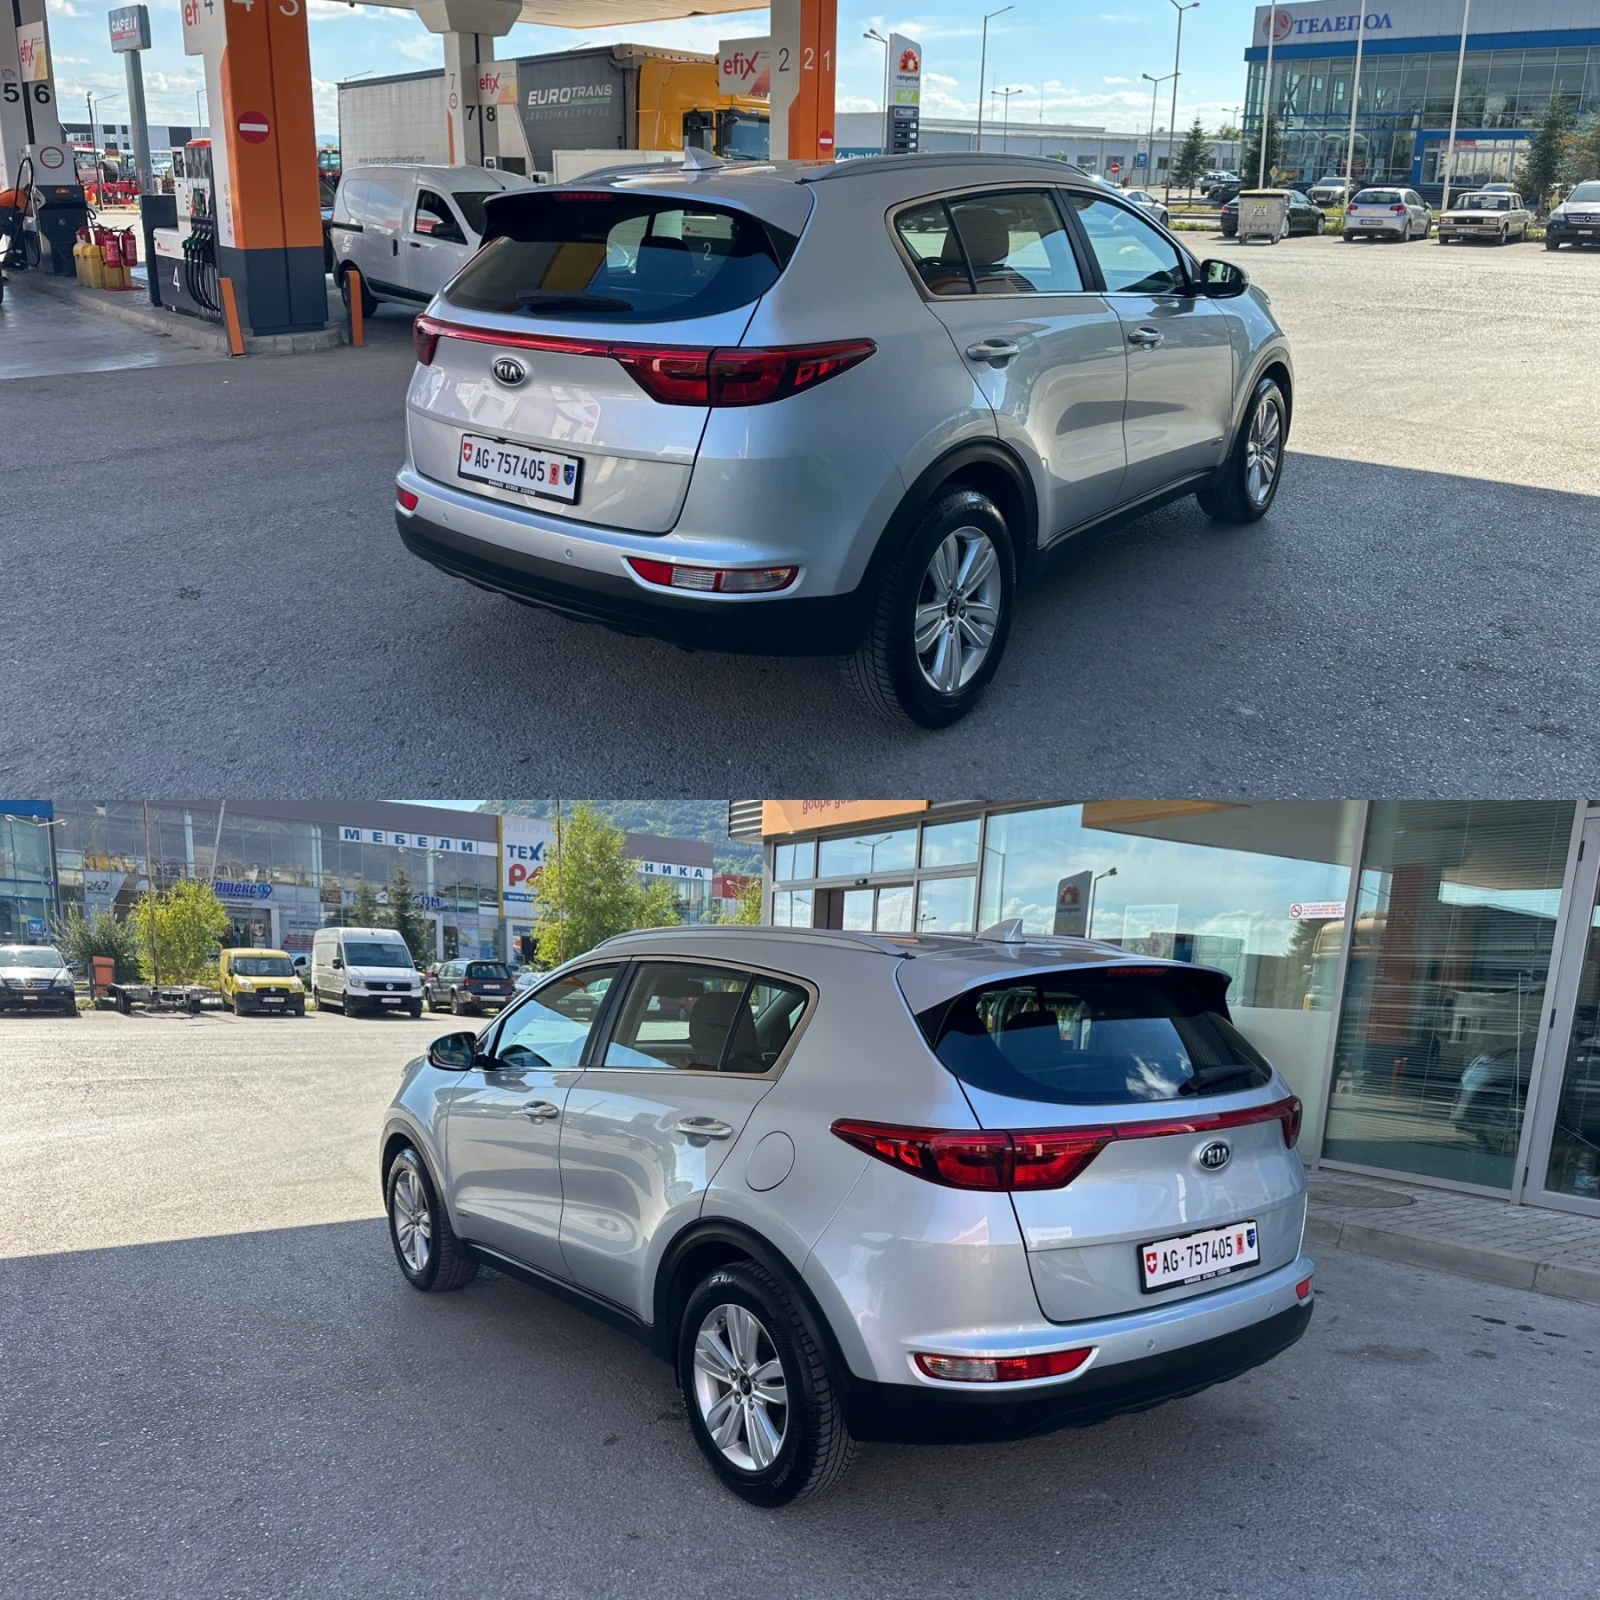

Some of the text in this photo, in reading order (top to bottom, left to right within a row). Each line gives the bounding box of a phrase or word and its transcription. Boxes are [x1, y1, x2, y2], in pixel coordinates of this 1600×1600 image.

[1293, 13, 1392, 34] ТЕЛЕПОЛ
[20, 38, 34, 67] efix
[778, 48, 789, 72] 2
[803, 47, 831, 71] 2 1
[723, 51, 759, 80] efix
[3, 83, 20, 103] 5
[33, 84, 50, 104] 6
[479, 72, 500, 95] efix
[527, 84, 612, 106] EUROTRANS
[465, 106, 476, 120] 7
[486, 106, 496, 122] 8
[703, 242, 712, 260] 2
[173, 266, 181, 292] 4
[496, 364, 518, 380] KIA
[344, 829, 473, 852] МЕБЕЛИ
[1207, 1148, 1227, 1164] KIA
